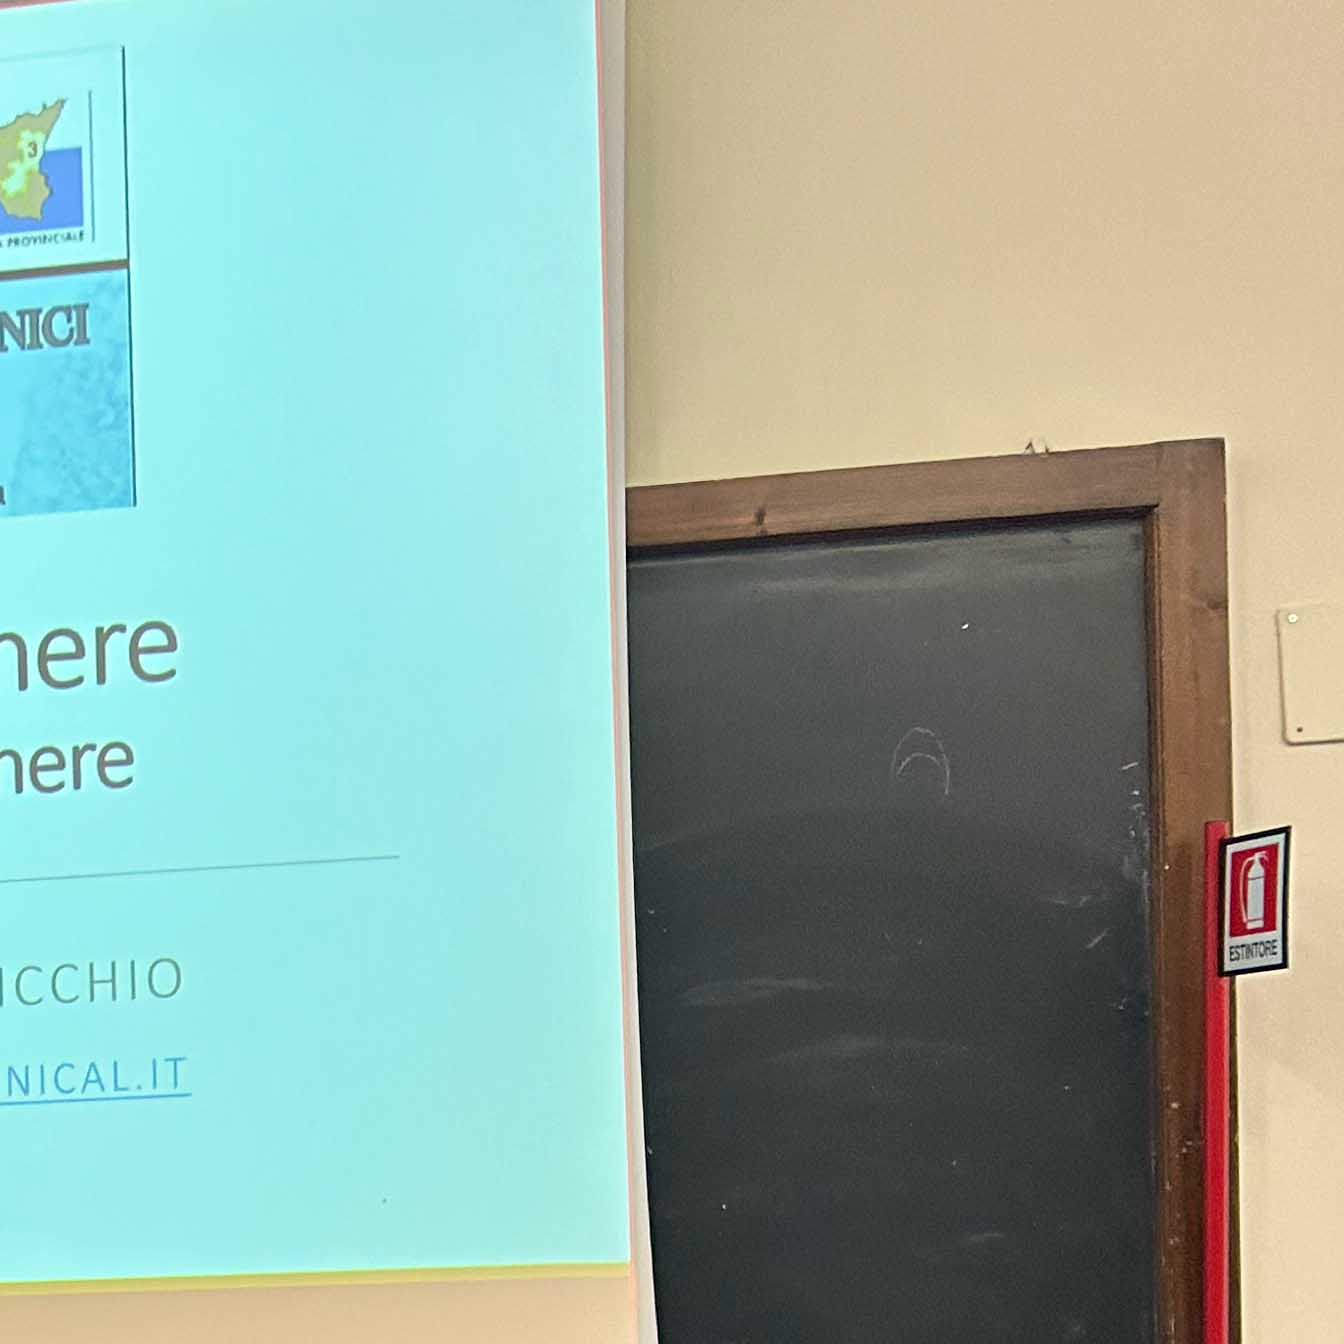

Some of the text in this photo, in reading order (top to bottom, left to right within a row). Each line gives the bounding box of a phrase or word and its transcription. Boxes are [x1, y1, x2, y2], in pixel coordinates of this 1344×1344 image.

[27, 140, 39, 158] 3
[7, 231, 85, 247] PROVINCIALE
[1229, 939, 1278, 962] ESTINTORE
